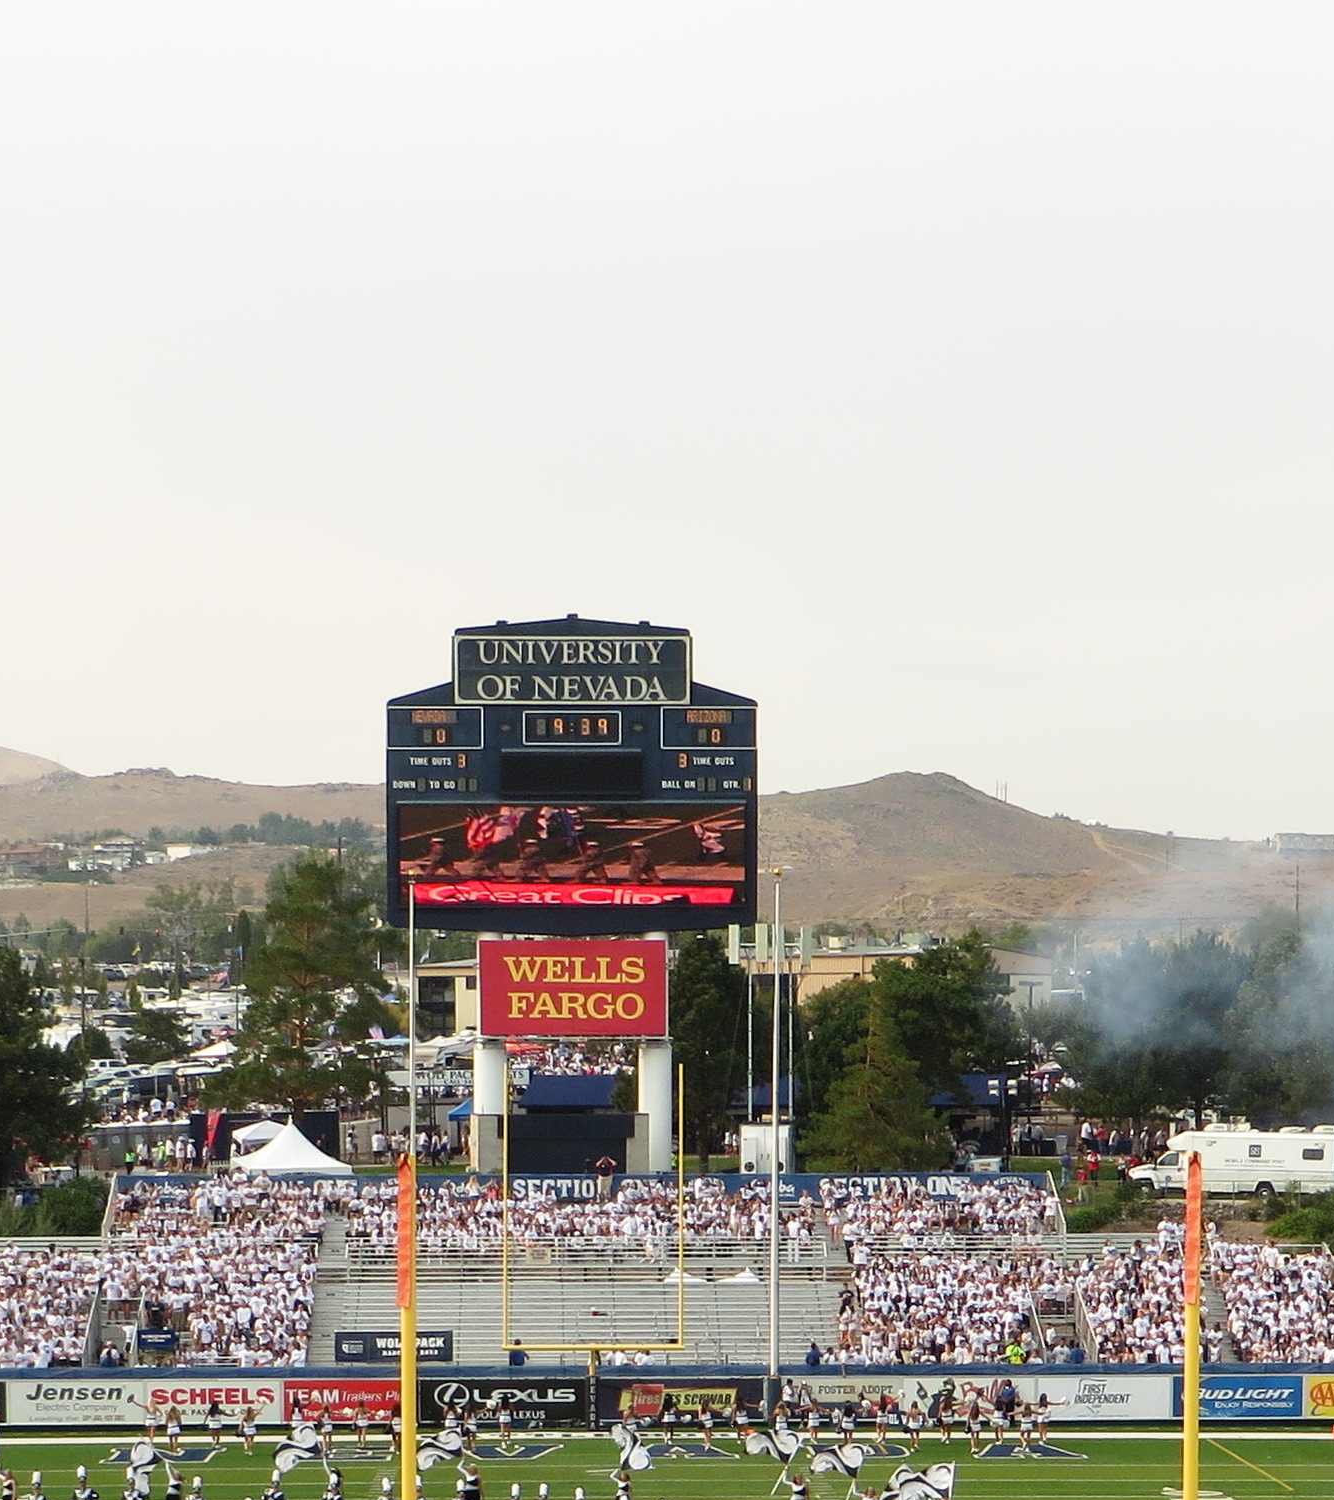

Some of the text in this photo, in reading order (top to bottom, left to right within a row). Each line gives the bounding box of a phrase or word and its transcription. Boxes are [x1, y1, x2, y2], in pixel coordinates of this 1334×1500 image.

[477, 640, 664, 666] UNIVERSITY
[476, 675, 667, 701] OF NEVADA
[409, 757, 429, 766] TIME
[432, 757, 452, 766] OUTS
[693, 757, 711, 766] TIME
[715, 757, 735, 766] OUTS
[392, 780, 456, 790] DOWN TO GO
[662, 780, 681, 789] BALL
[684, 780, 696, 789] ON
[428, 885, 564, 905] Great
[503, 956, 646, 985] WELLS
[506, 992, 646, 1021] FARGO
[375, 1337, 402, 1349] WOL
[26, 1383, 123, 1401] Jensen
[818, 1385, 856, 1395] FOSTER
[861, 1385, 894, 1395] ADOPT
[1082, 1383, 1107, 1394] FIRST
[1235, 1387, 1295, 1401] LIGHT
[150, 1387, 275, 1405] SCHEELS
[286, 1388, 340, 1404] TEAM
[341, 1390, 383, 1402] Trailers
[473, 1388, 577, 1403] LEXUS
[683, 1392, 733, 1405] SCHWAB
[1074, 1393, 1132, 1405] INDEPENDENT
[35, 1403, 119, 1413] Electric Company
[1214, 1401, 1295, 1409] ENJOY RESPONSIBLY
[513, 1410, 546, 1420] LEXUS
